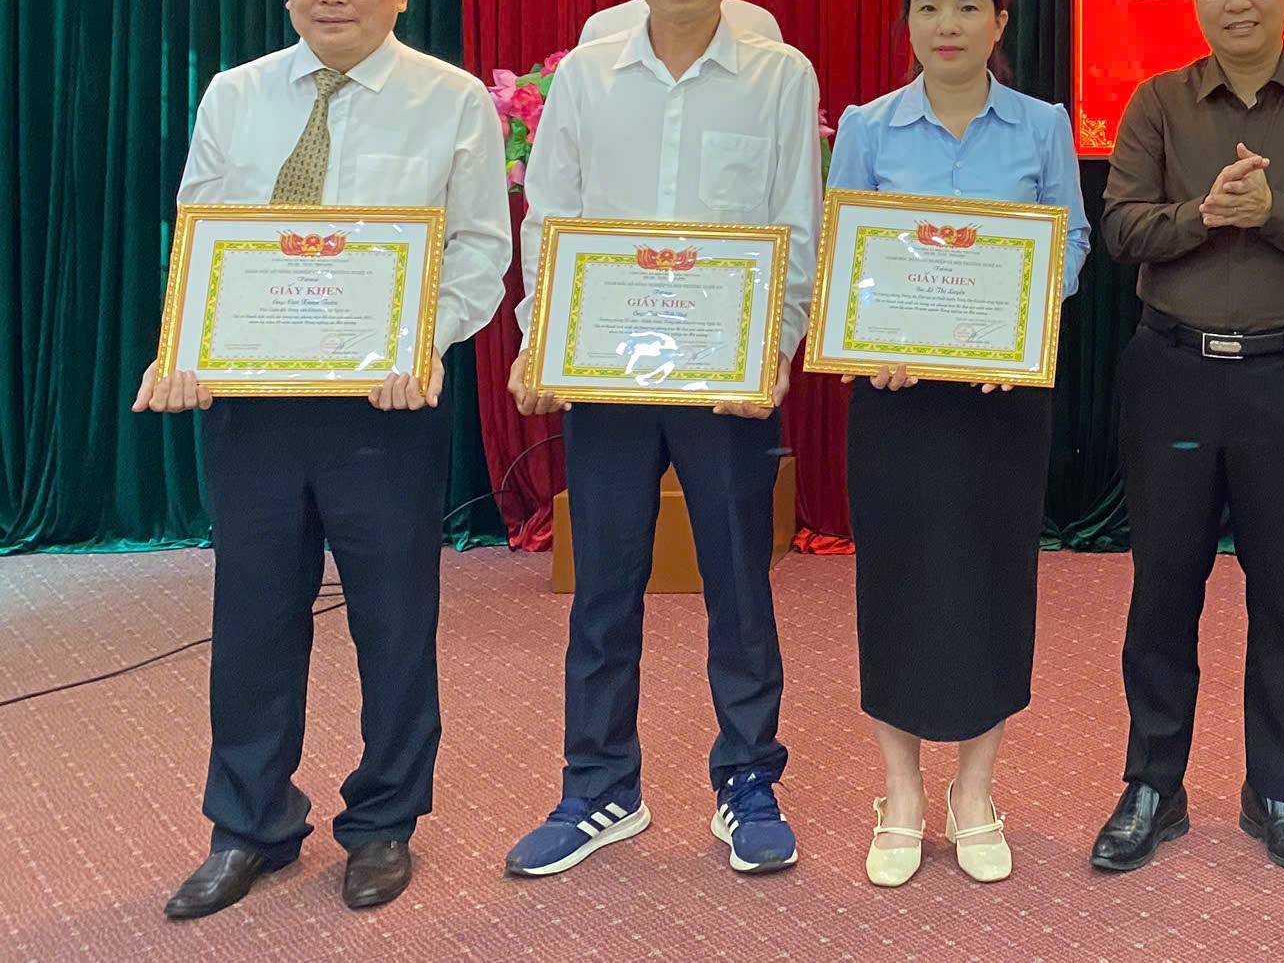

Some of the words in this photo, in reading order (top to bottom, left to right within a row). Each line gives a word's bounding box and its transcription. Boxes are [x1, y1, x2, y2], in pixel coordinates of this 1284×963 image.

[907, 271, 939, 284] GIẤY
[941, 276, 976, 286] KHEN
[269, 282, 304, 296] GIẤY
[306, 286, 345, 296] KHEN
[627, 295, 659, 307] GIẤY
[661, 298, 697, 309] KHEN
